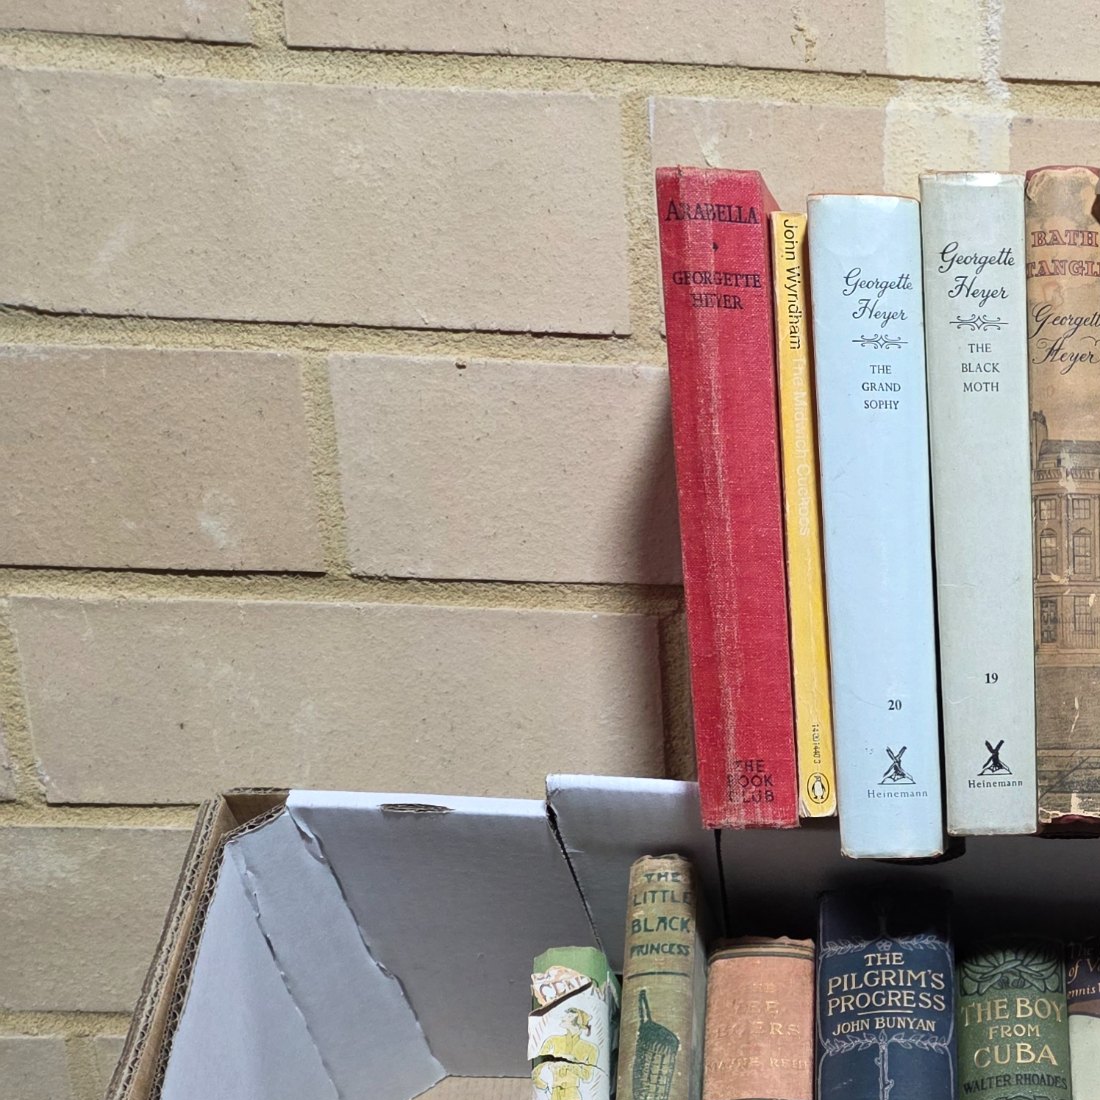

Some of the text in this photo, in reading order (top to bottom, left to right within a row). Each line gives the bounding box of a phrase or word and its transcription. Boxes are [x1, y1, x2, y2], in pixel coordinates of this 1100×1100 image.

[665, 198, 760, 225] ARABELLA
[783, 219, 798, 261] John
[1031, 230, 1098, 248] BATH
[939, 241, 1016, 273] Georgette
[672, 271, 762, 289] GEORGETTE
[842, 267, 914, 297] Georgette
[948, 276, 1010, 308] Heyer
[690, 293, 744, 310] HEYER
[784, 265, 803, 350] Wyndham
[852, 298, 908, 328] Heyer
[967, 342, 992, 354] THE
[869, 364, 892, 375] THE
[960, 361, 1001, 374] BLACK
[861, 381, 902, 393] GRAND
[962, 381, 1000, 393] MOTH
[863, 399, 900, 411] SOPHY
[984, 672, 999, 685] 19
[888, 700, 903, 711] 20
[967, 779, 1024, 788] Heinemann
[867, 789, 928, 799] Heinemann
[643, 872, 682, 883] THE
[633, 890, 691, 907] LITTLE
[630, 916, 690, 935] BLACK
[629, 944, 690, 958] PRINCESS
[863, 952, 905, 967] THE
[1067, 958, 1080, 985] of
[826, 969, 945, 996] PILGRIM'S
[826, 990, 946, 1016] PROGRESS
[960, 996, 1065, 1027] THE BOY
[832, 1016, 936, 1036] JOHN BUNYAN
[988, 1024, 1041, 1040] FROM
[973, 1042, 1059, 1069] CUBA
[963, 1073, 1068, 1094] WALTER RHOADES
